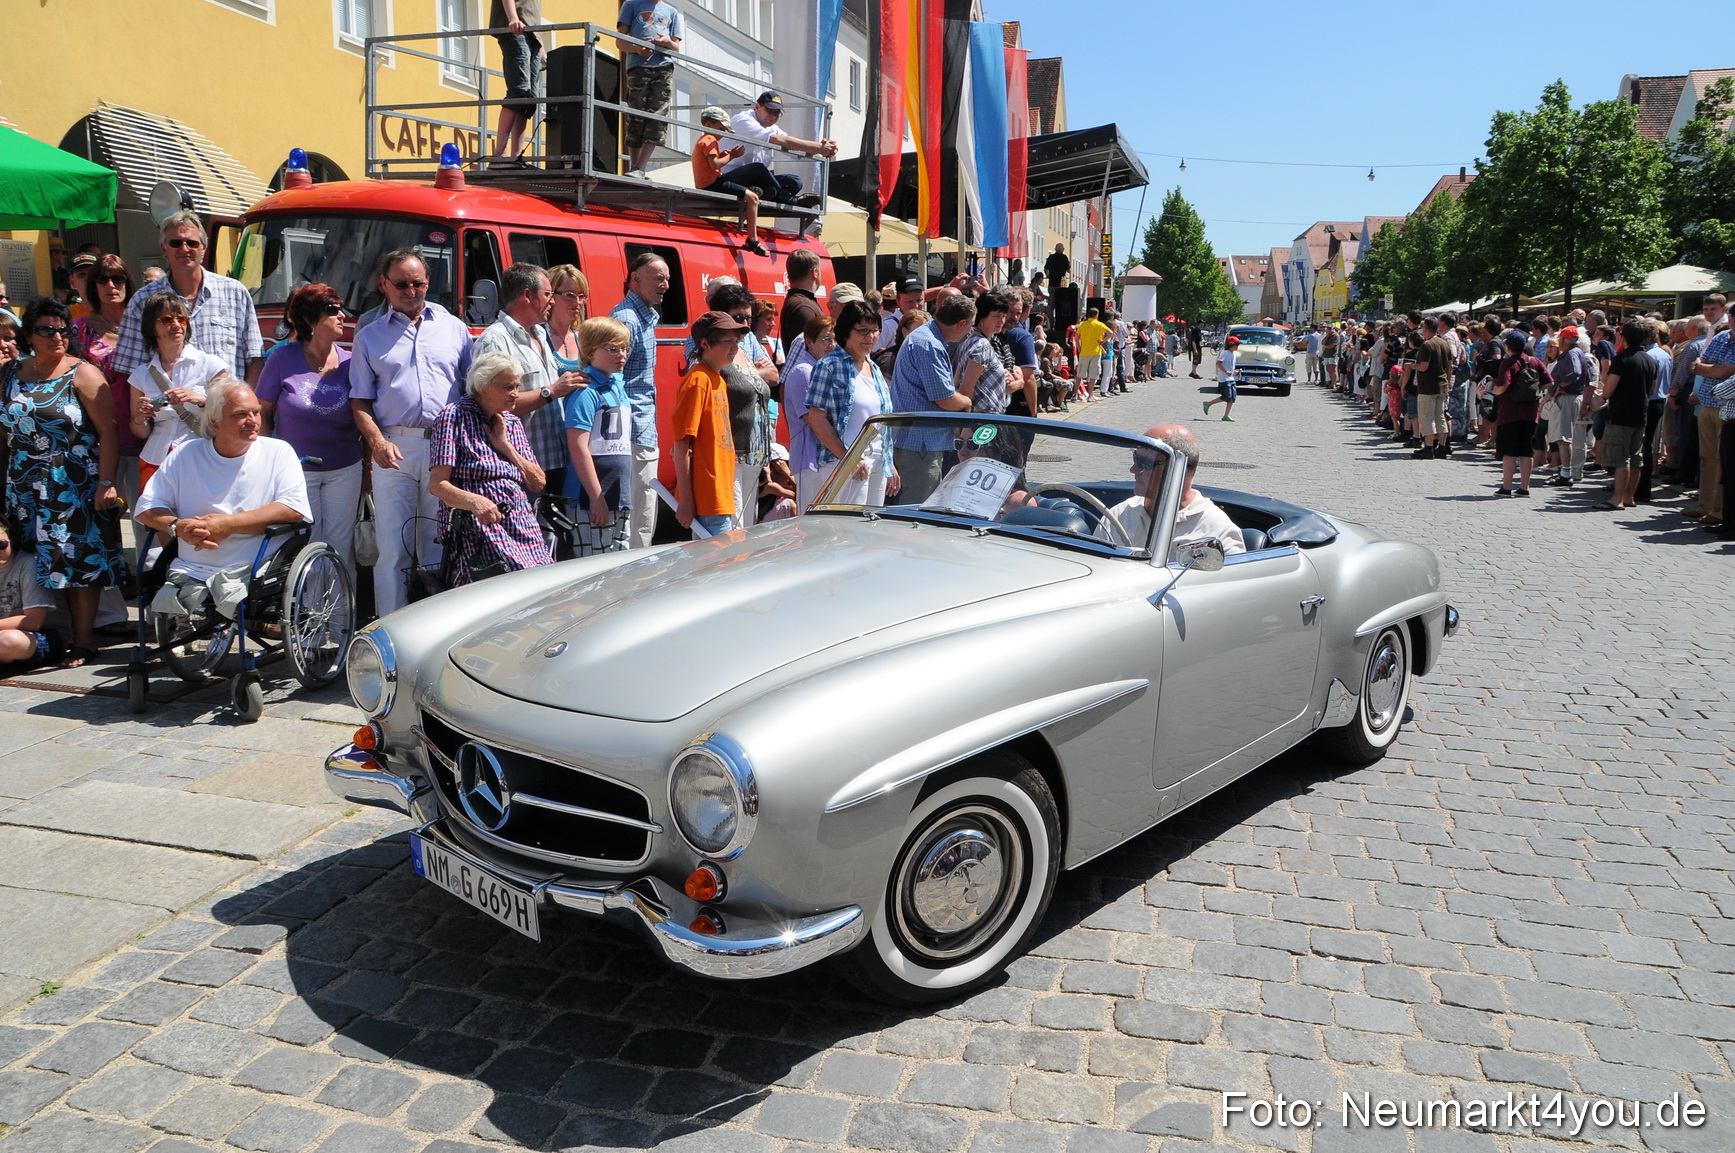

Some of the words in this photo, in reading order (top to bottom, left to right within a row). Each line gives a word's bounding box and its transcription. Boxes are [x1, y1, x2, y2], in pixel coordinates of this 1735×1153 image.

[381, 114, 441, 159] CAFE
[1102, 234, 1112, 287] HOTEL
[979, 427, 993, 439] B
[965, 469, 998, 491] 90
[426, 845, 451, 888] NM
[460, 864, 473, 900] G
